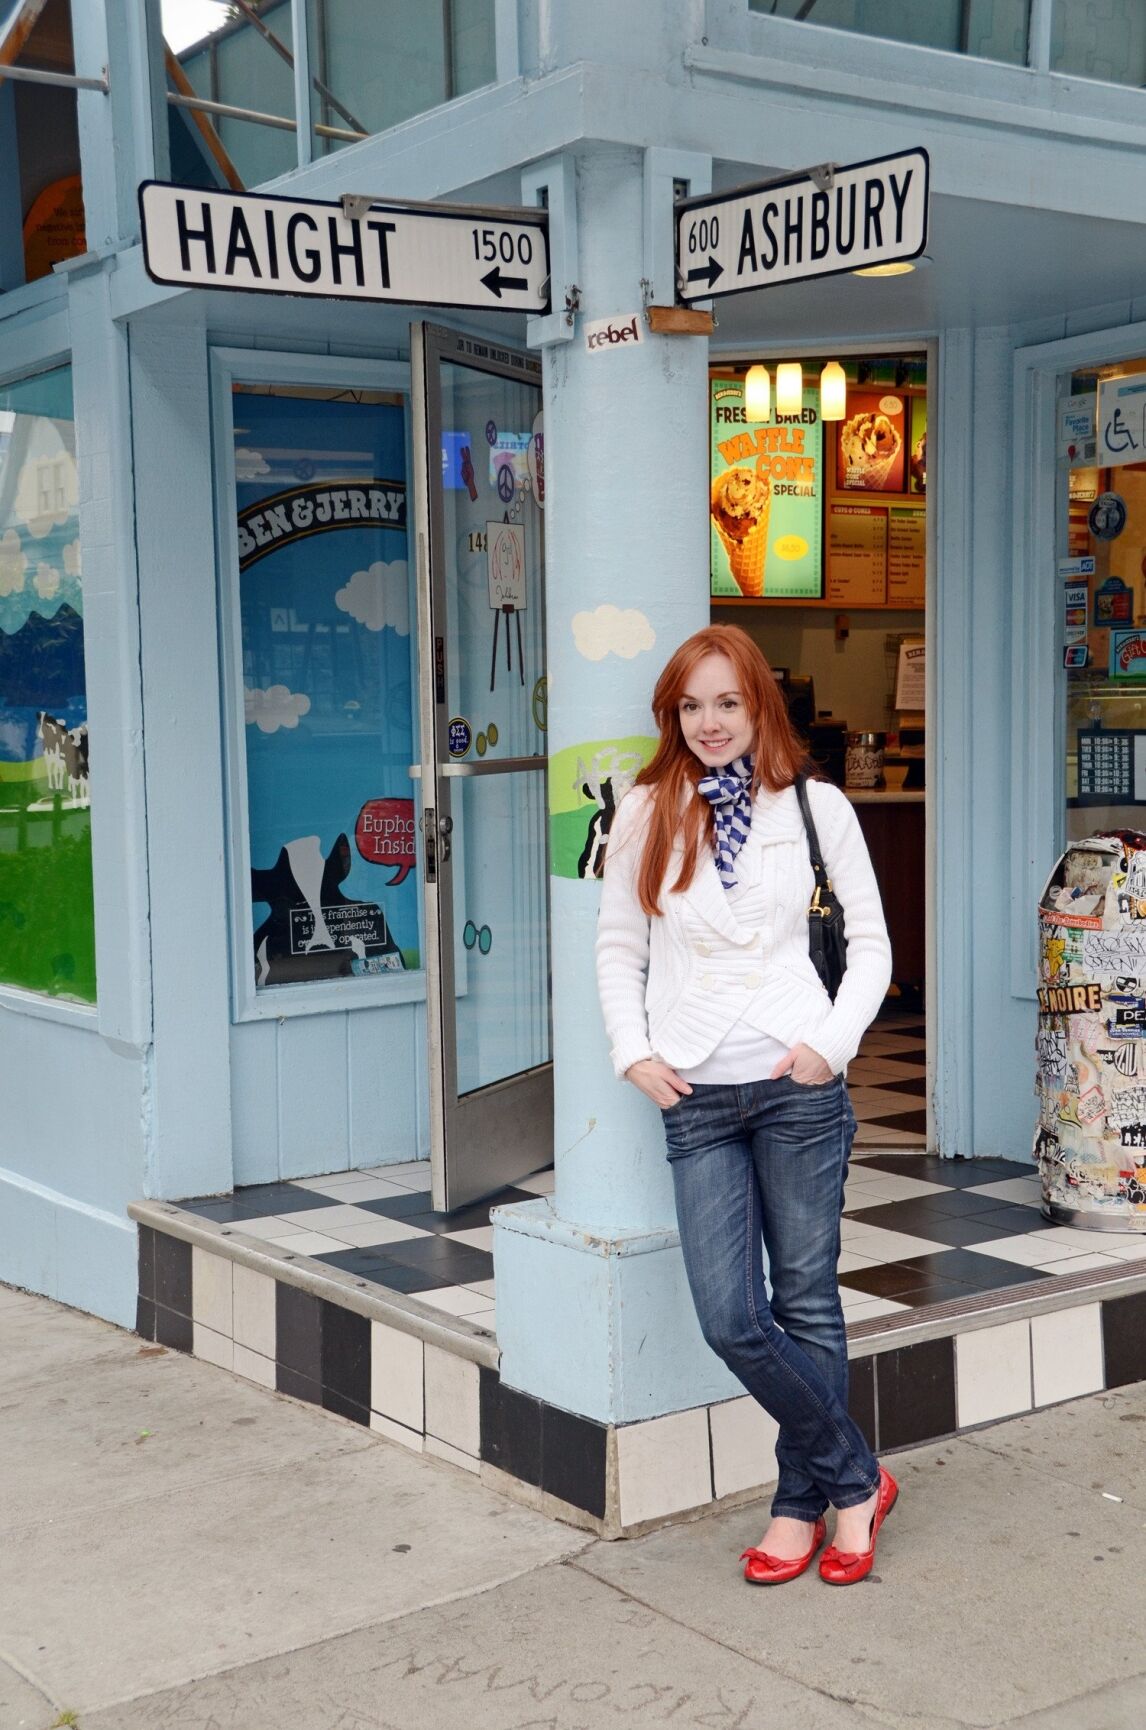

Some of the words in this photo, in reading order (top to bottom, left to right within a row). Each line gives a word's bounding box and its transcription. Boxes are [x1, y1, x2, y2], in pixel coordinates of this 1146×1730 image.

[688, 216, 720, 254] 600
[737, 169, 914, 275] ASHBURY
[175, 199, 397, 289] HAIGHT
[472, 229, 533, 265] 1500
[588, 317, 639, 349] rebel
[717, 428, 805, 465] WAFFLE
[756, 454, 816, 482] CONE
[773, 484, 816, 497] SPECIAL
[1069, 592, 1085, 601] VISA
[1121, 640, 1141, 664] Gift
[302, 926, 310, 935] is
[311, 919, 374, 935] iependently
[328, 907, 368, 919] franchise
